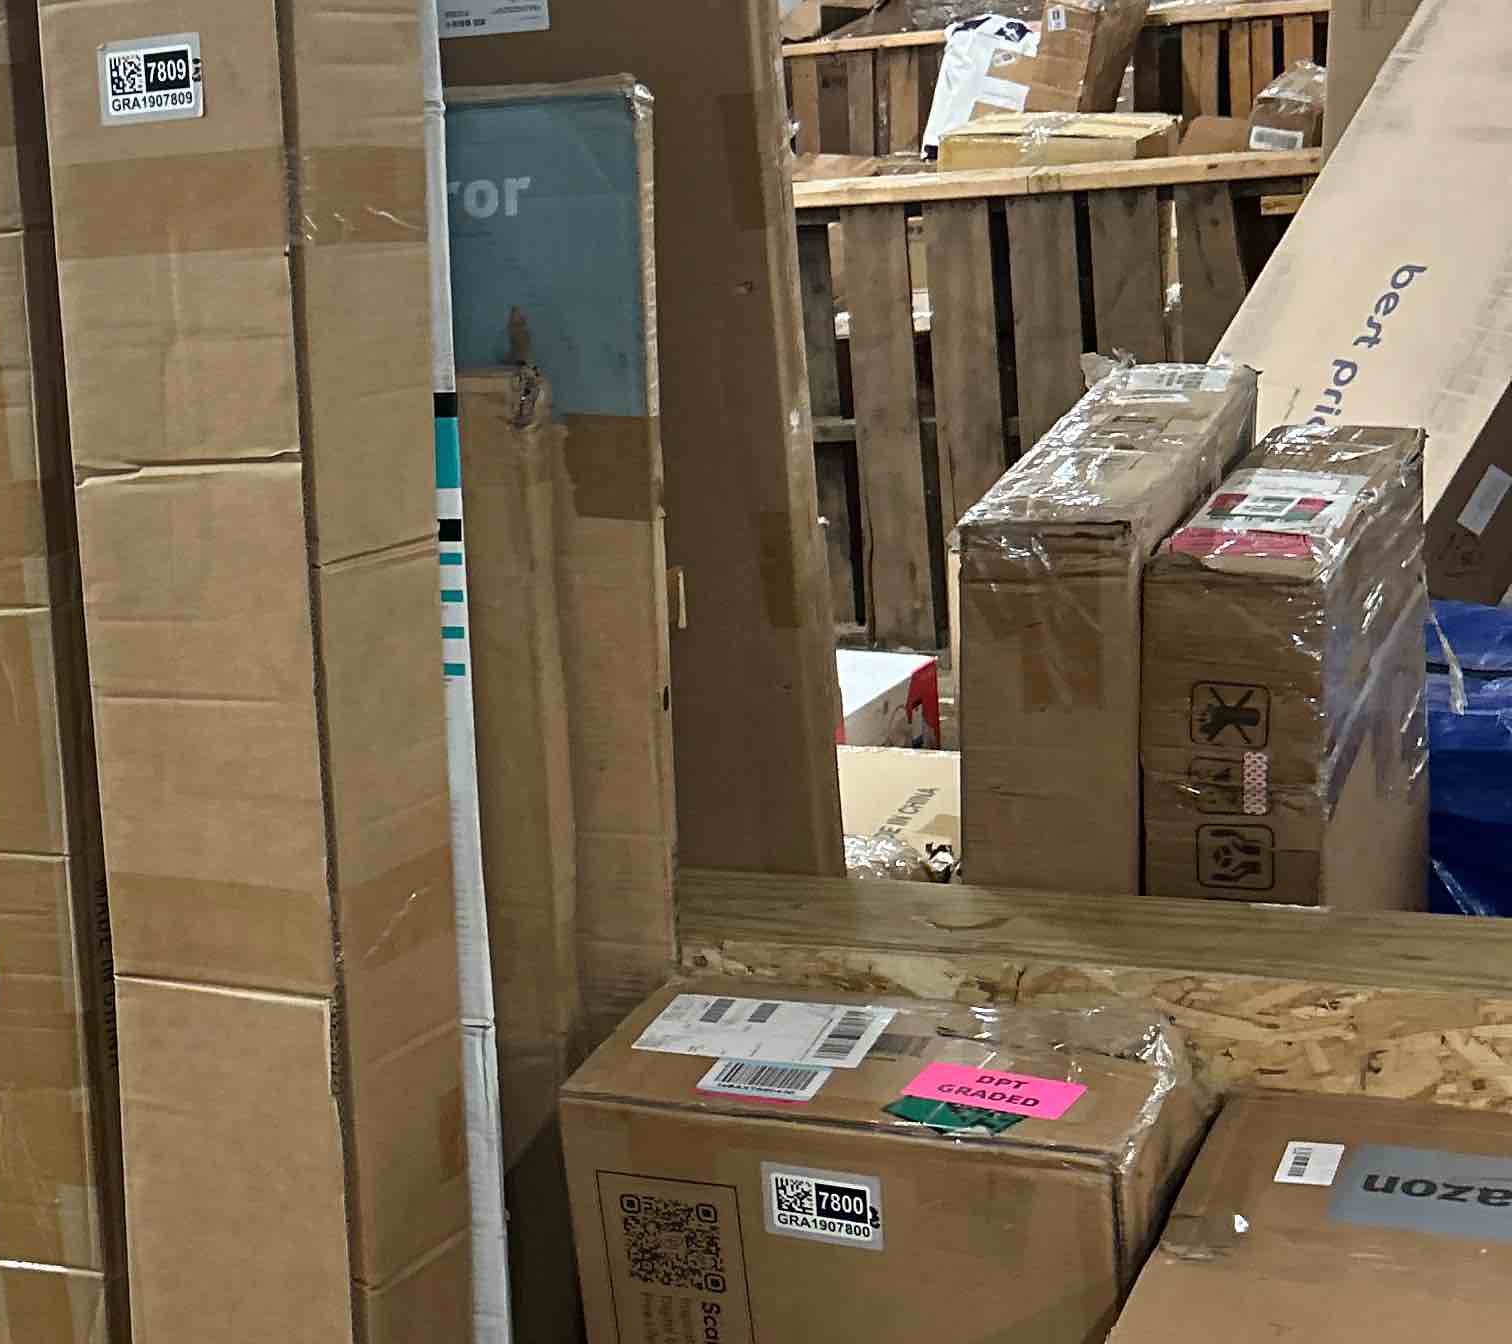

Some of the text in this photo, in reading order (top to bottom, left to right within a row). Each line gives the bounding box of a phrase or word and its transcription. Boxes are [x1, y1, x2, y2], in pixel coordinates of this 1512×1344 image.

[147, 57, 187, 84] 7809
[111, 90, 193, 112] GRA1907809
[975, 1074, 1030, 1091] DPT
[937, 1083, 1041, 1108] GRADED
[818, 1191, 864, 1216] 7800
[777, 1213, 871, 1238] GRA1907800
